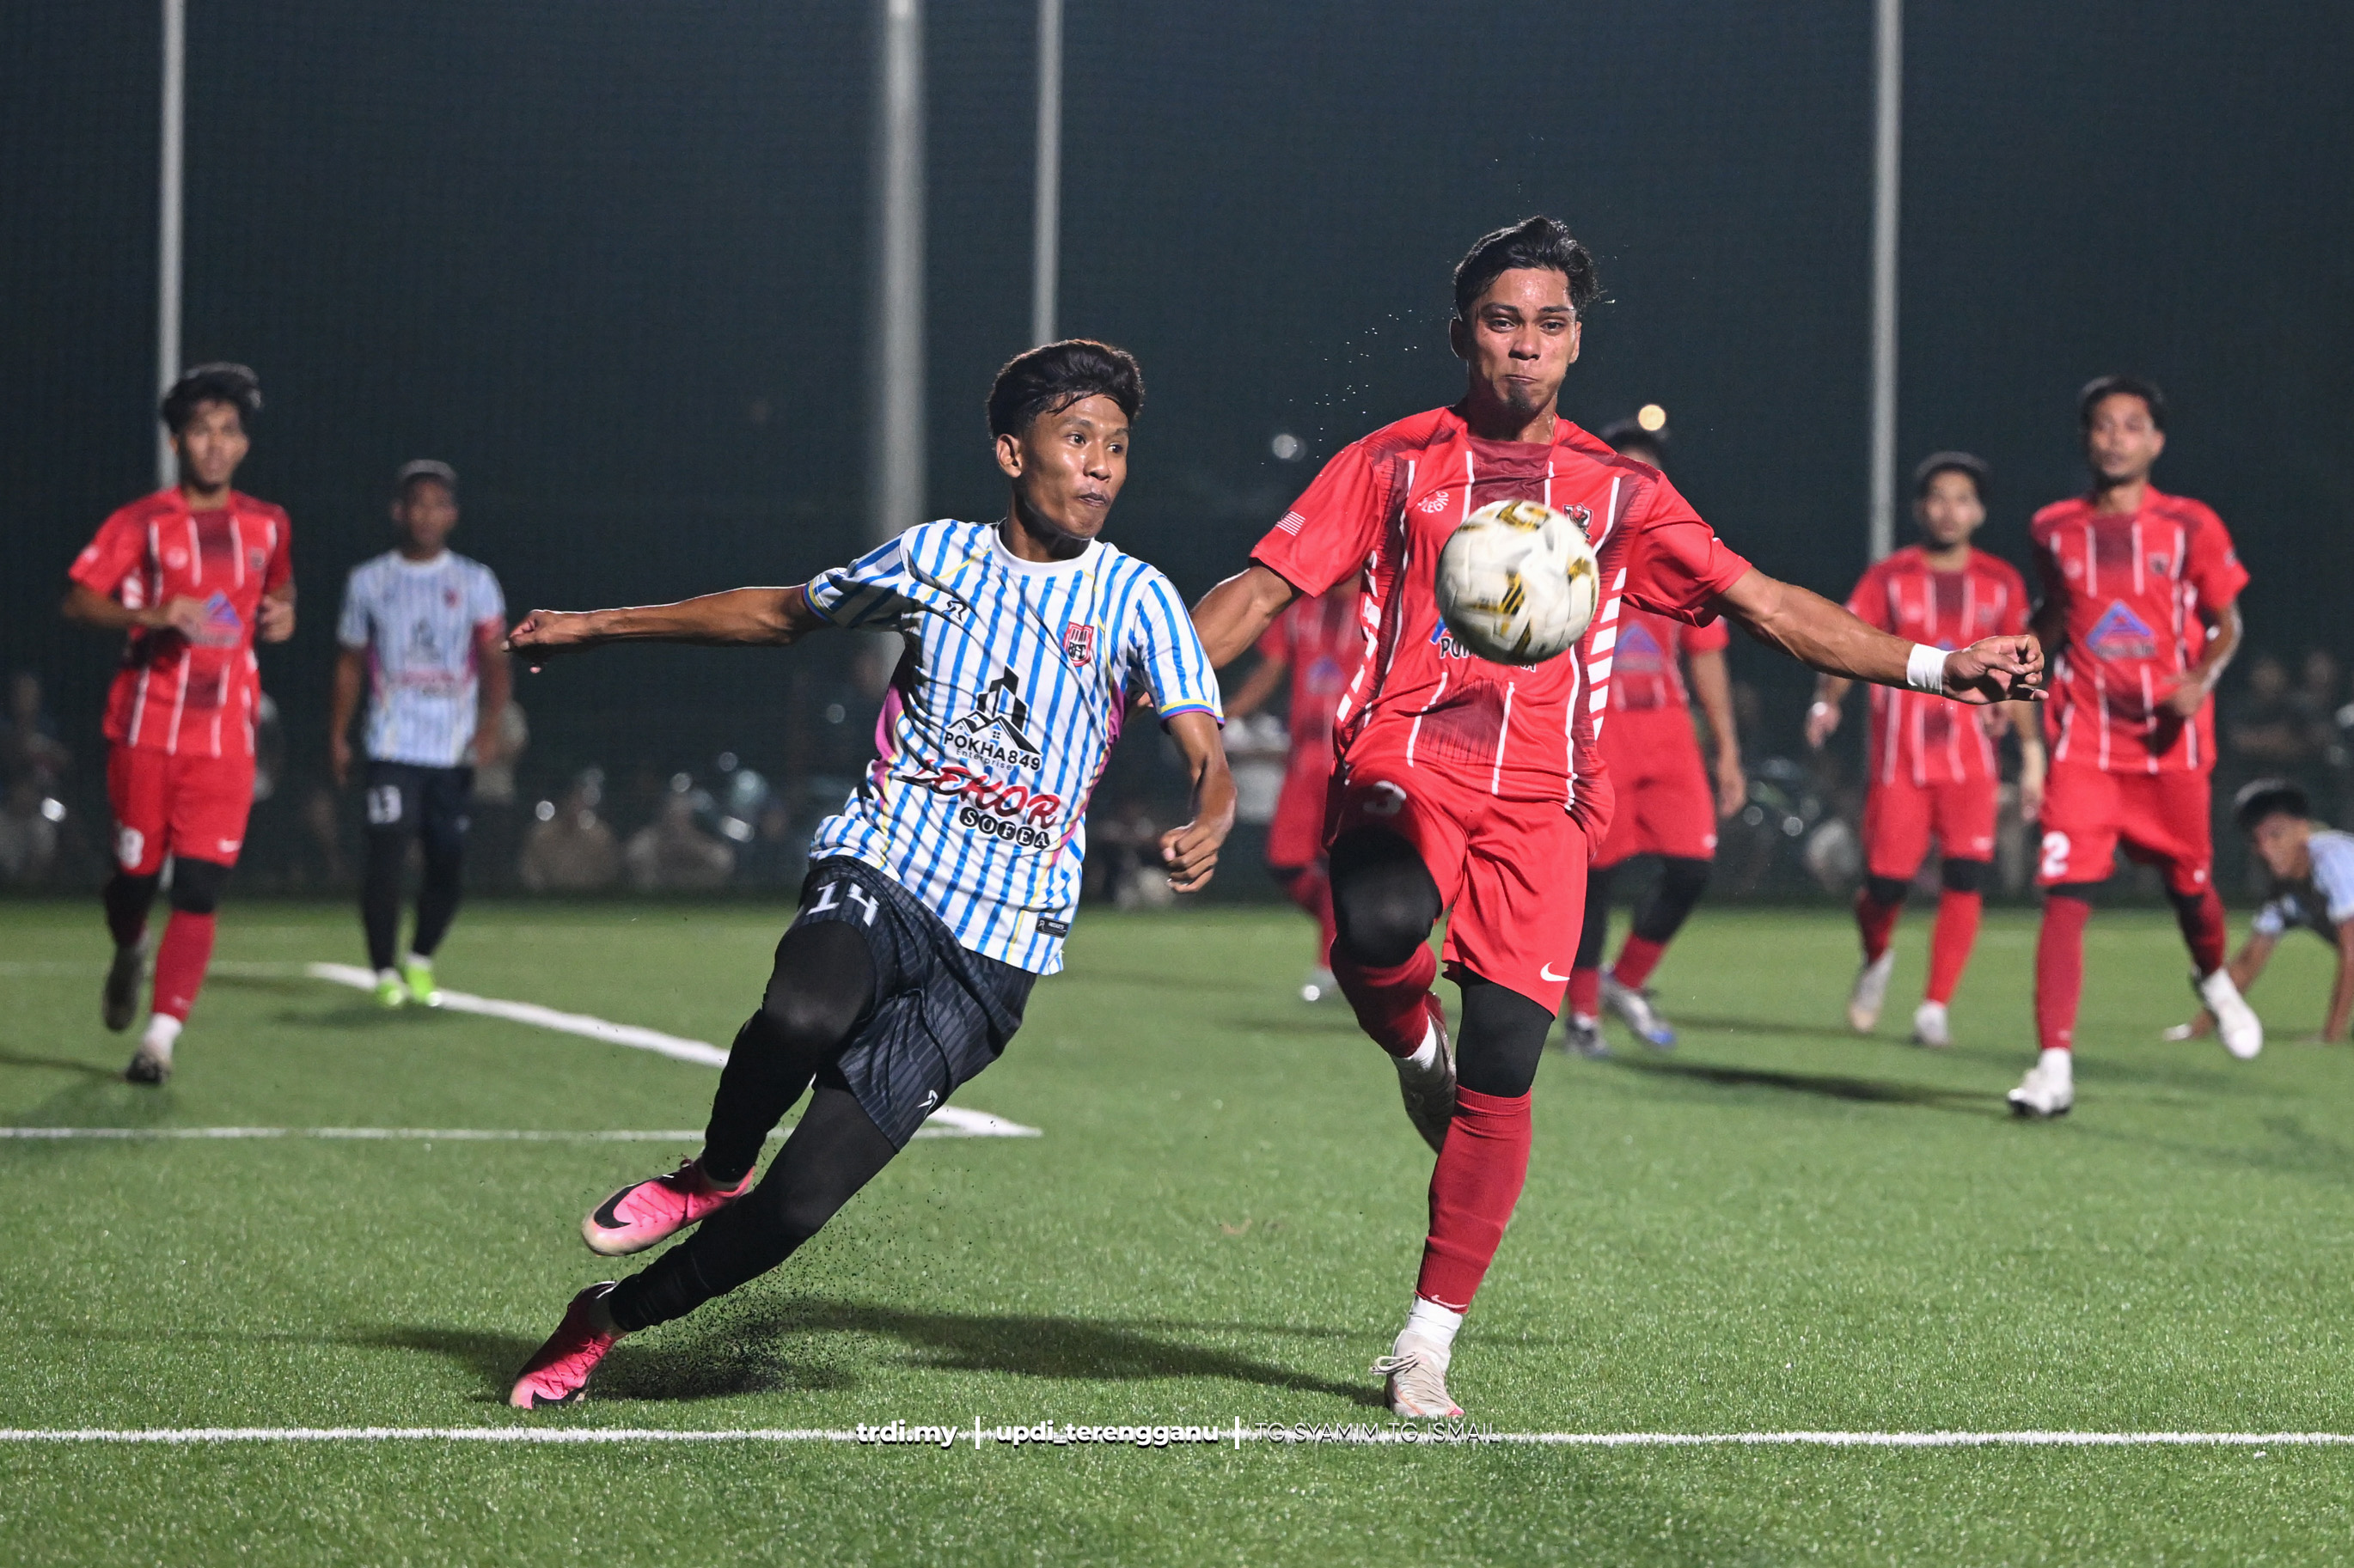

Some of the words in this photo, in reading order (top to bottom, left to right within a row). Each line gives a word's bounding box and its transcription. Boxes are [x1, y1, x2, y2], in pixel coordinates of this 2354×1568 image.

[944, 731, 1042, 772] POKHA849
[956, 747, 1014, 772] Enterprise
[959, 806, 1051, 850] SOFEA
[2041, 830, 2071, 876] 2
[806, 881, 880, 928] 14
